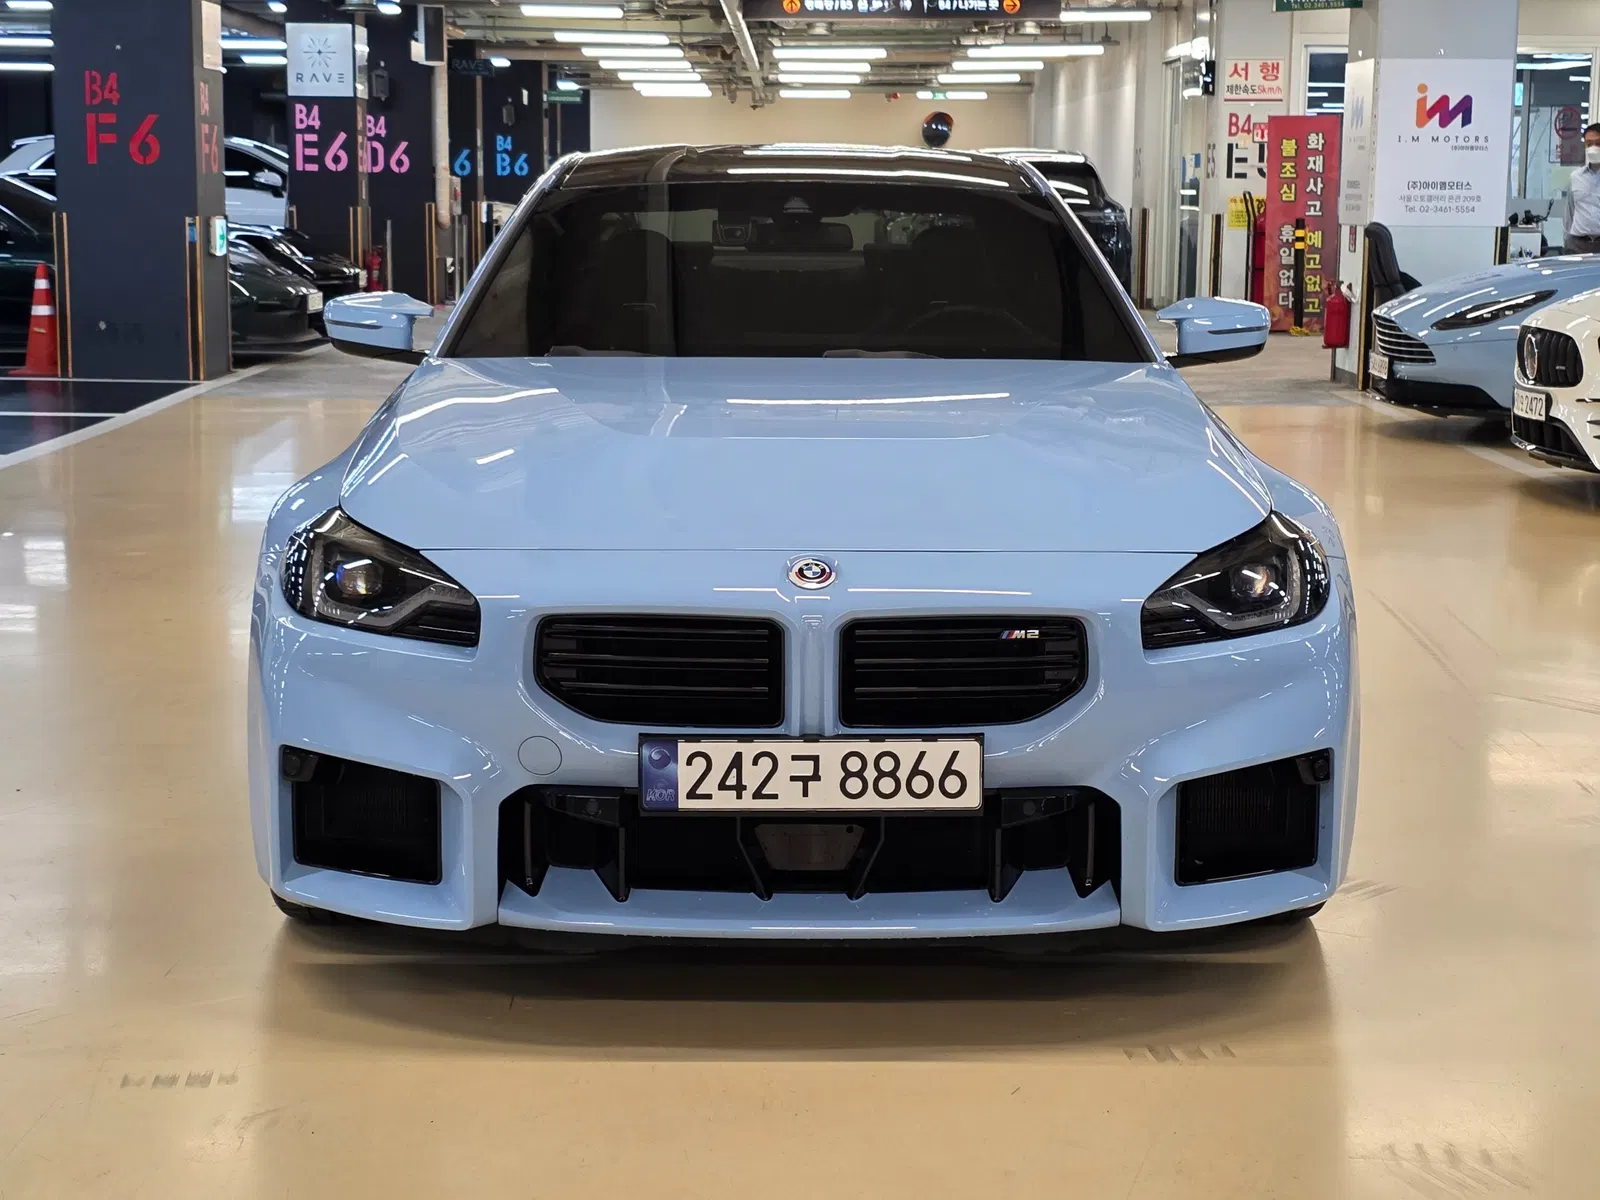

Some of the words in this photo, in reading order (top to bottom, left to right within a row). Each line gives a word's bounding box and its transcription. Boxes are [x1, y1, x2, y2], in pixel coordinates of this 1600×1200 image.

[85, 70, 120, 106] B4
[295, 72, 345, 84] RAVE
[295, 104, 321, 130] B4
[366, 115, 387, 138] B4
[1228, 113, 1252, 137] B4
[496, 135, 512, 151] B4
[1431, 135, 1489, 143] MOTORS
[295, 131, 349, 172] E6
[496, 153, 528, 176] B6
[1279, 138, 1298, 202] 불조심
[1305, 132, 1325, 217] 화재사고
[1405, 205, 1417, 213] Tel.
[1419, 205, 1476, 214] 02-3461-5554
[685, 750, 822, 801] 242구
[839, 750, 968, 800] 8866
[646, 788, 676, 801] KOR
